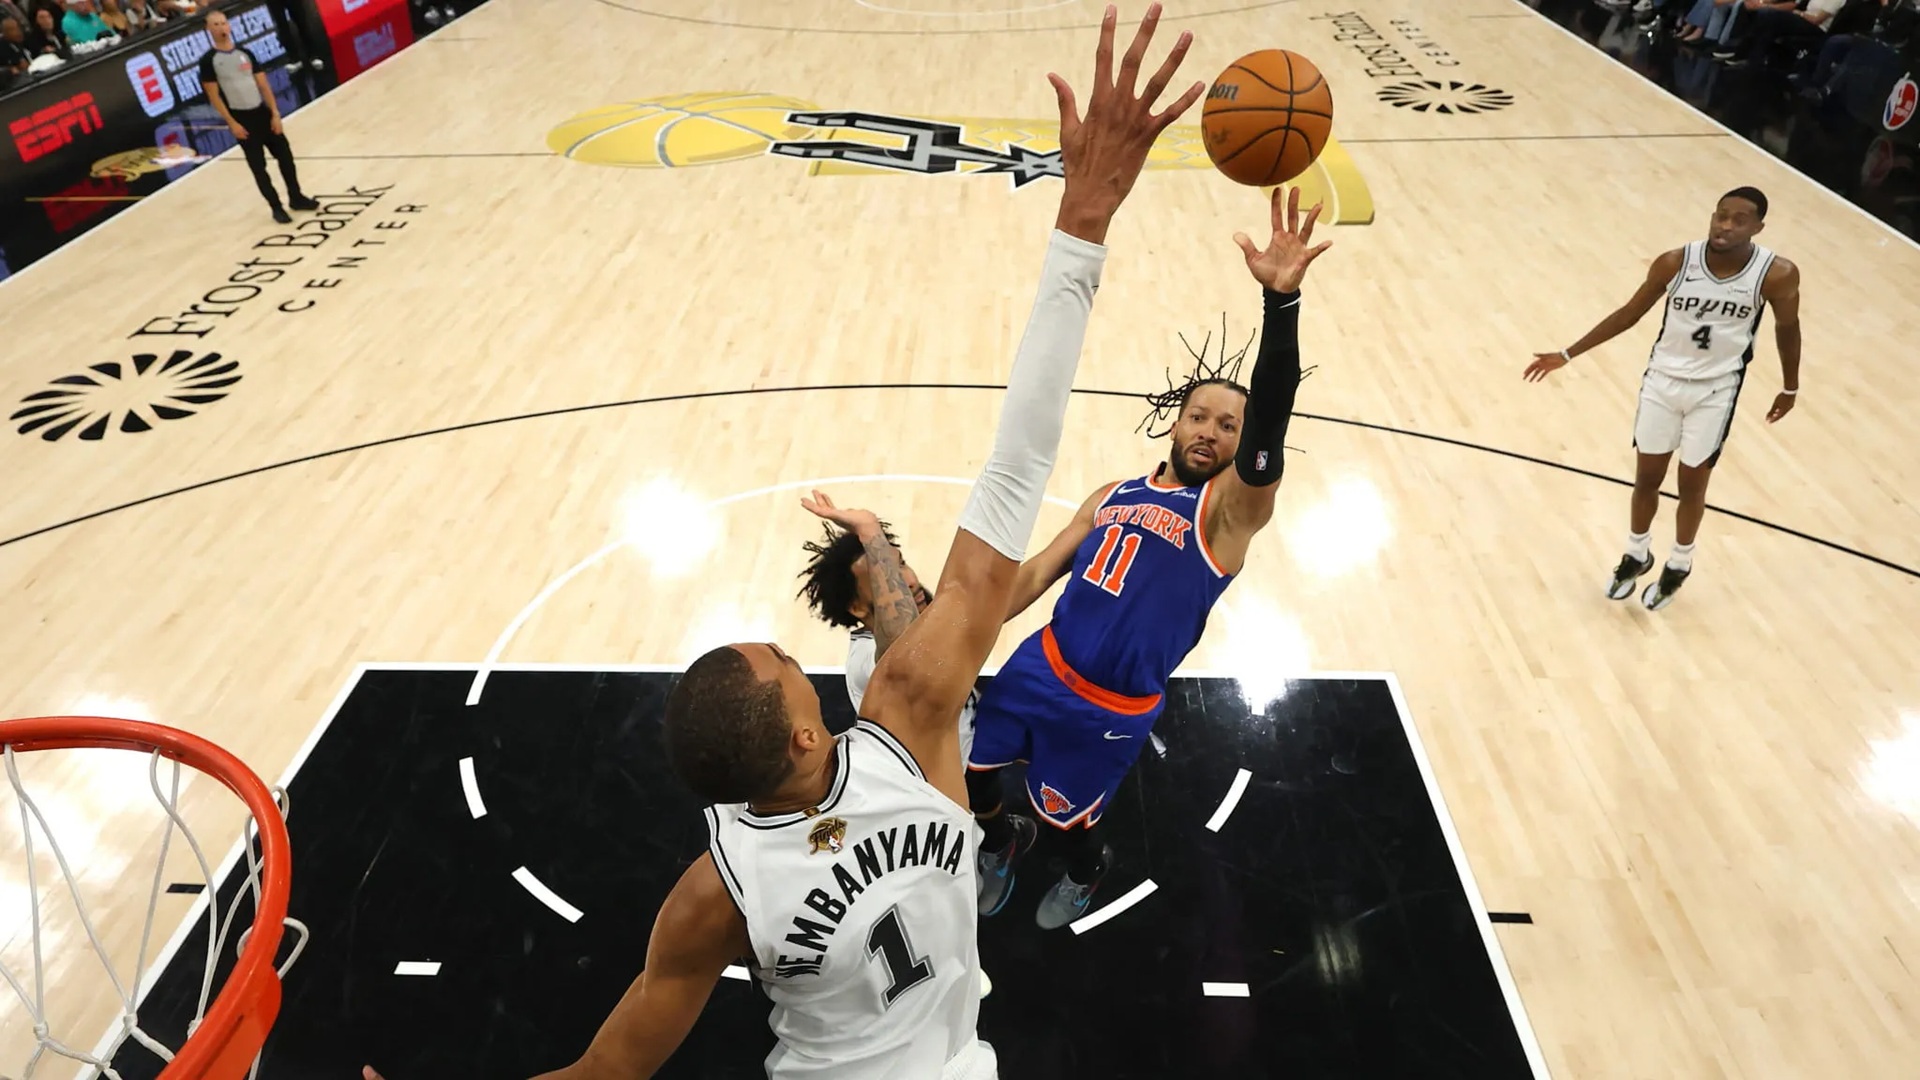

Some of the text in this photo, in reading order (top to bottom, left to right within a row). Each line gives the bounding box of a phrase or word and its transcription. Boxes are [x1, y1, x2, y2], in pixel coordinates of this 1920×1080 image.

[160, 30, 212, 73] STREAM
[8, 91, 104, 163] ESPN
[126, 183, 396, 340] Frost Bank
[278, 203, 429, 314] CENTER
[1673, 296, 1752, 319] SPURS
[1691, 325, 1712, 350] 4
[1082, 522, 1143, 598] 11
[1095, 503, 1195, 551] NEW YORK
[863, 903, 936, 1012] 1
